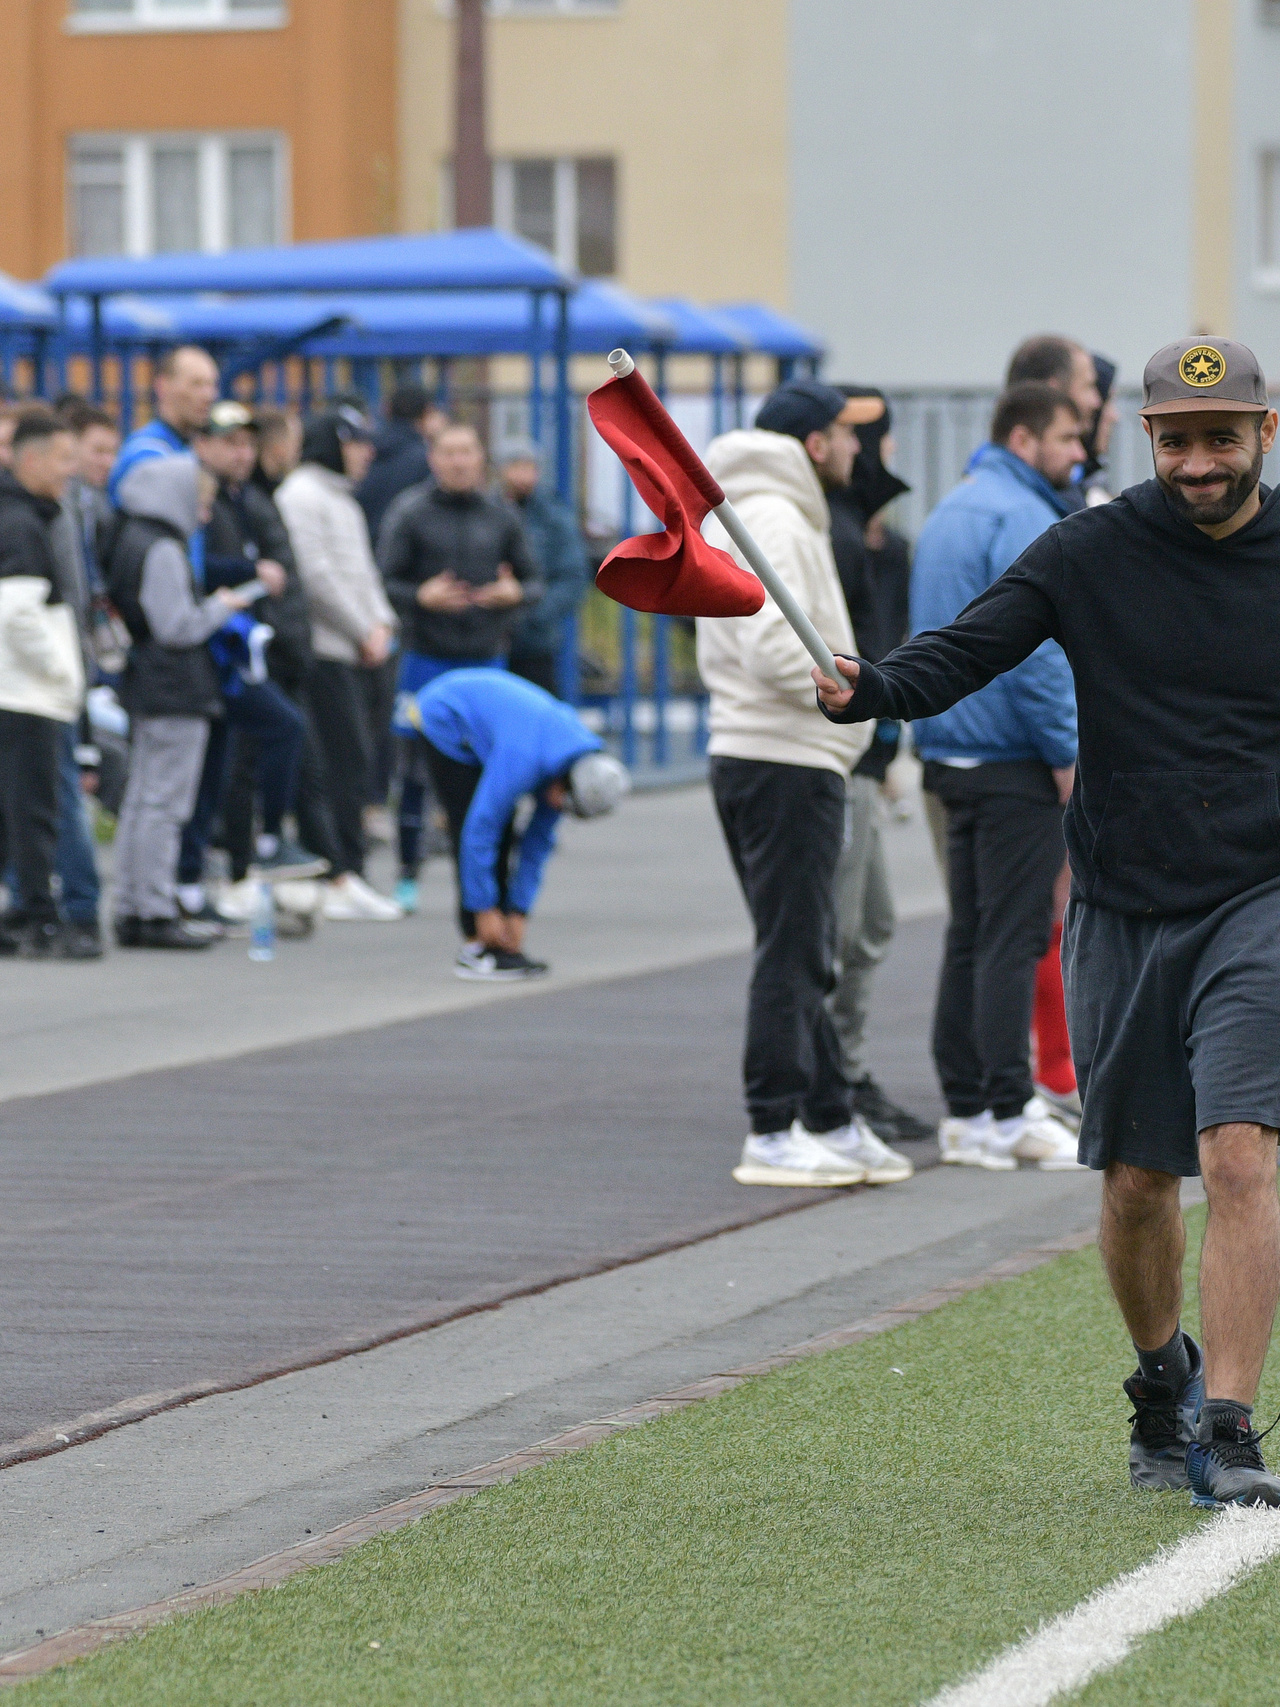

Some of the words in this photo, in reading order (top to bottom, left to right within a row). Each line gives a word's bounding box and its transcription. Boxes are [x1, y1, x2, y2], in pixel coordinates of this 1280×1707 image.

[1186, 350, 1218, 363] CONVERSE
[1187, 373, 1198, 383] ALL
[1200, 373, 1216, 383] STAR
